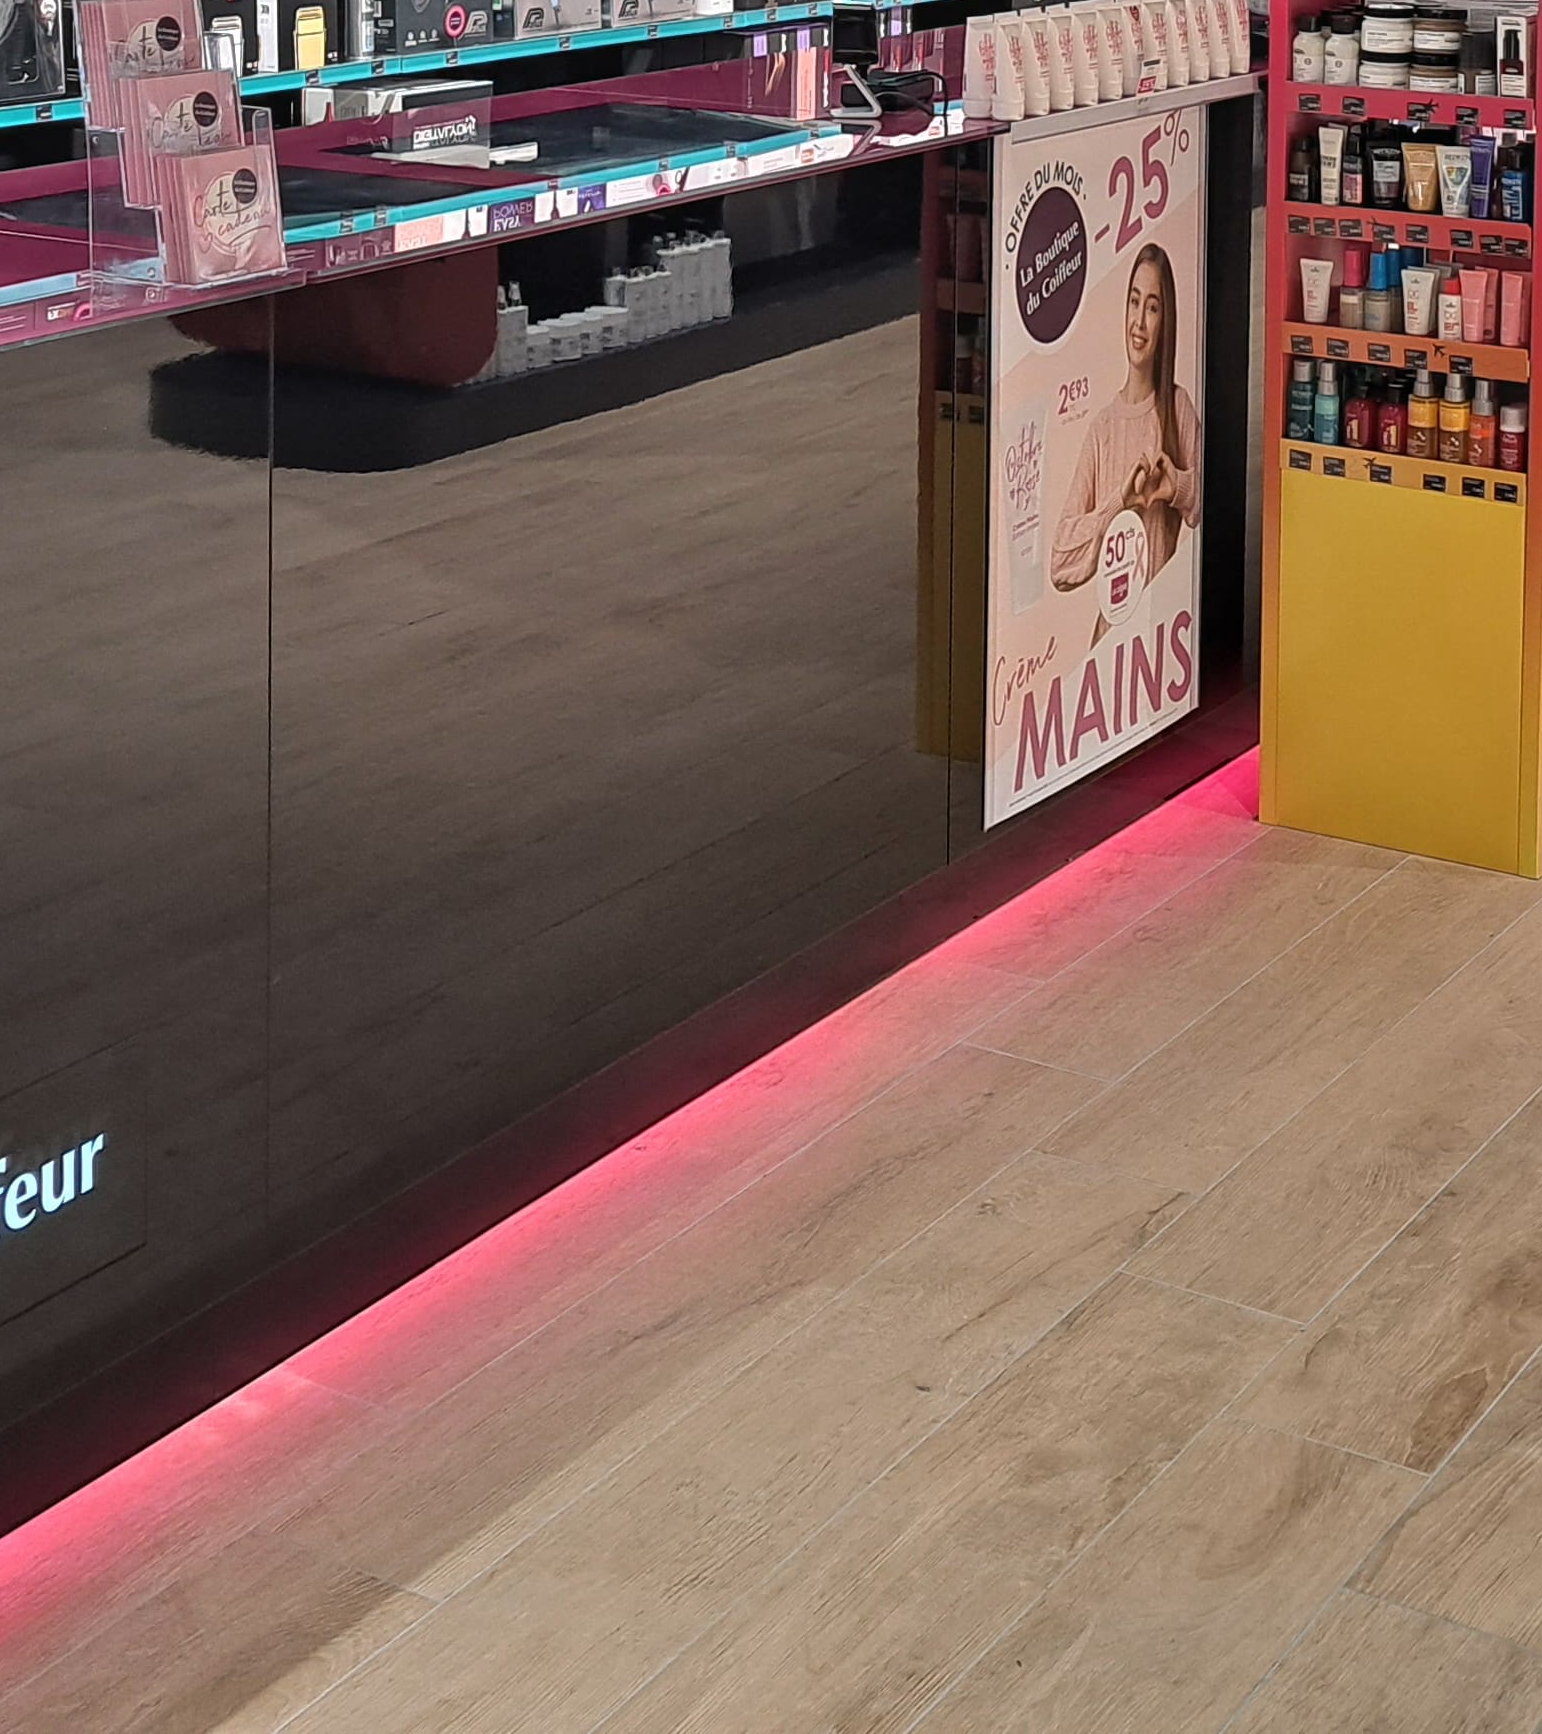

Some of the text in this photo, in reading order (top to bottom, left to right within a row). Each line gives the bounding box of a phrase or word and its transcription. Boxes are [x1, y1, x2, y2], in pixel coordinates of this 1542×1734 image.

[194, 180, 232, 227] Carte
[1005, 161, 1083, 253] OFFRE DU MOIS
[1095, 109, 1190, 254] -25%
[218, 207, 271, 236] cadeau
[1020, 221, 1080, 287] La Boutique
[1026, 251, 1083, 316] du Coiffeur
[1058, 376, 1089, 415] 2€93
[1013, 609, 1192, 794] MAINS
